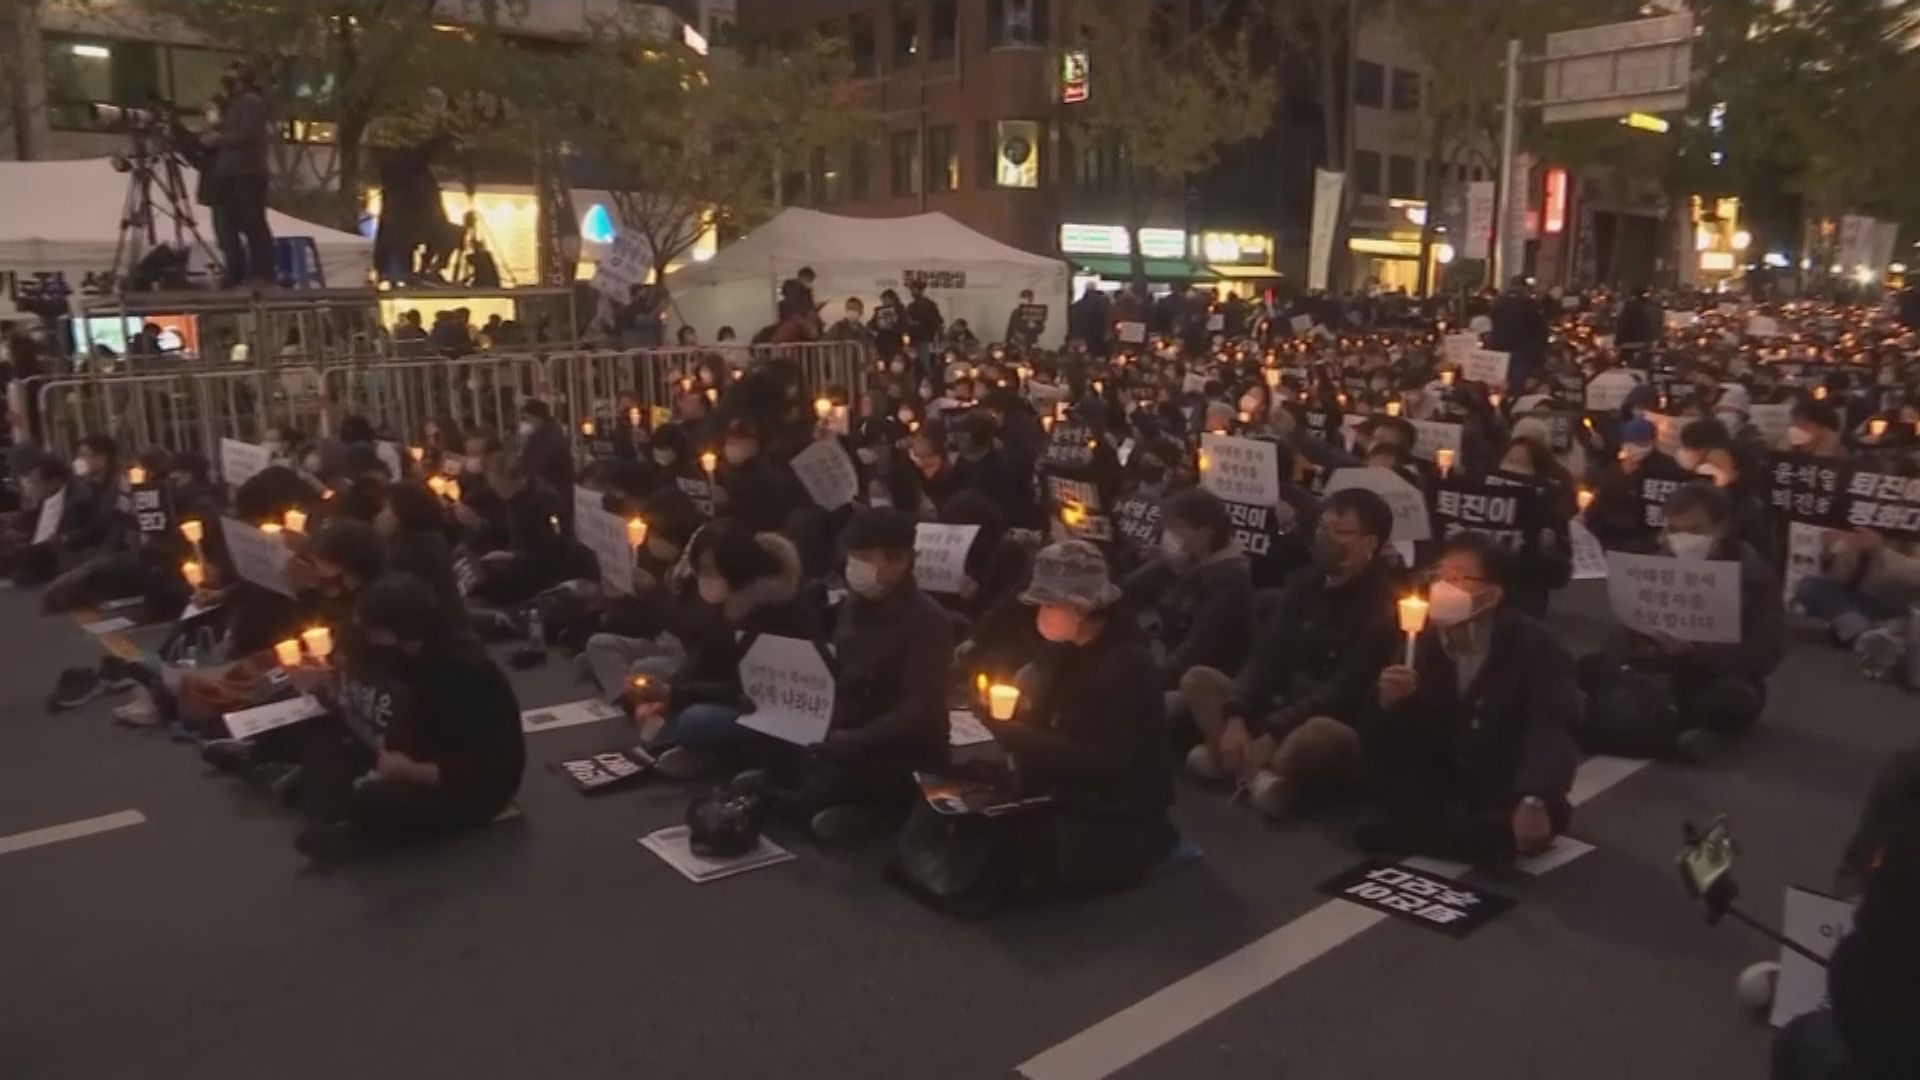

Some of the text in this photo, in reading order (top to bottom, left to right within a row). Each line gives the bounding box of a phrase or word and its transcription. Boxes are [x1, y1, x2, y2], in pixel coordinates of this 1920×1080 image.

[1437, 489, 1517, 525] 퇴진이
[1626, 566, 1716, 588] 이태원 참사
[1633, 607, 1715, 629] 추모합니다
